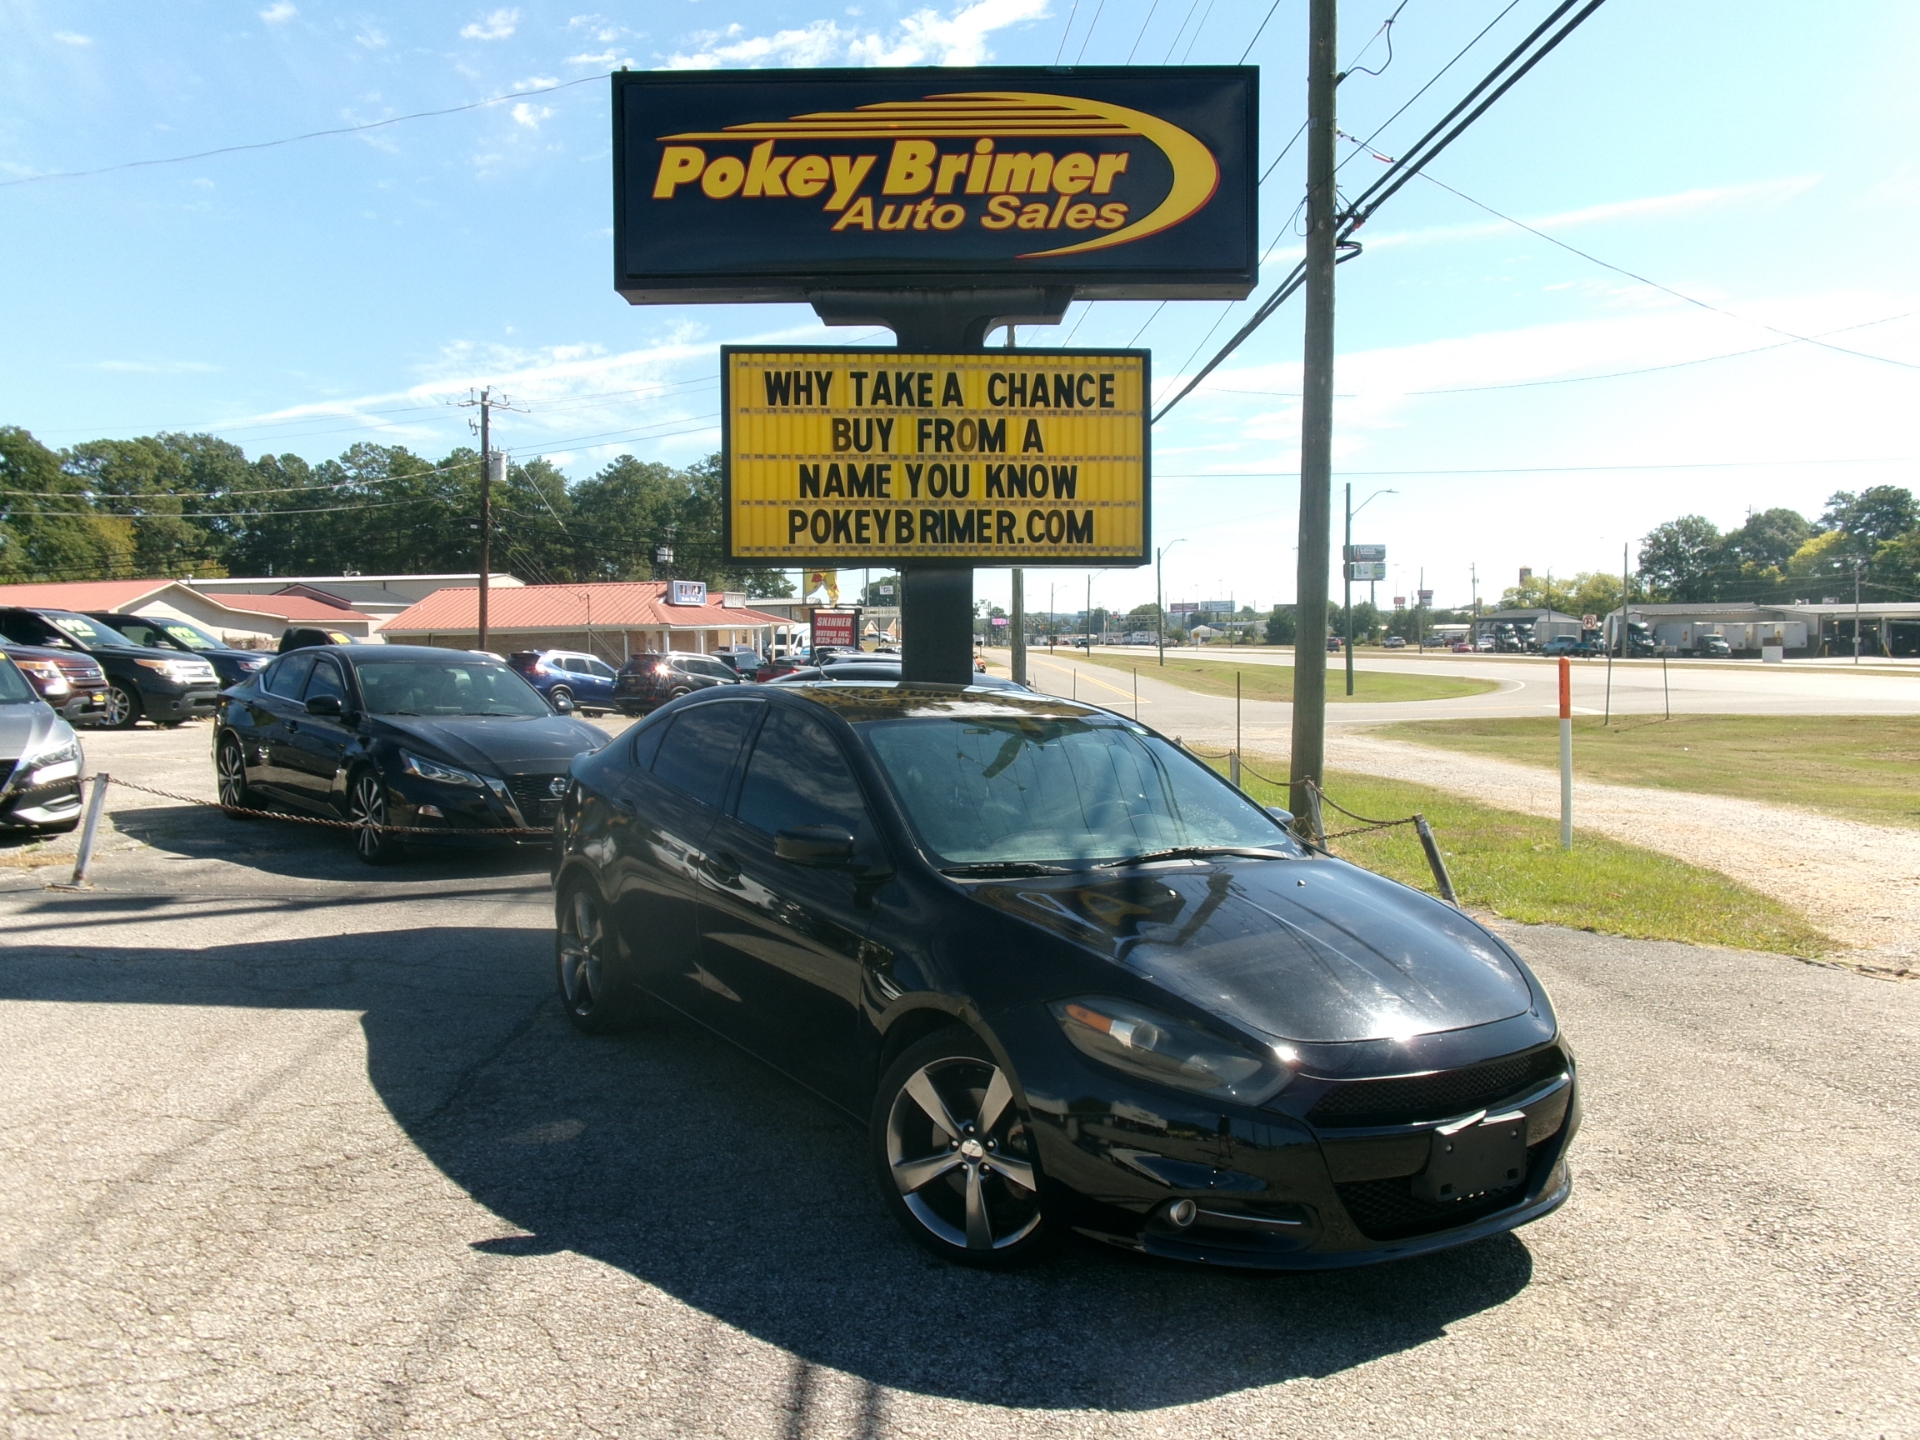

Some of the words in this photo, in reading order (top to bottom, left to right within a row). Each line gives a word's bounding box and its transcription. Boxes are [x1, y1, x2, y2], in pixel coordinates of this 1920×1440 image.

[652, 139, 877, 211] Pokey
[880, 138, 1128, 195] Brimer
[831, 196, 967, 231] Auto
[979, 196, 1129, 230] Sales
[764, 371, 833, 406] WHY
[850, 371, 934, 407] TAKE
[942, 373, 964, 407] A
[987, 373, 1115, 408] CHANCE
[832, 418, 894, 452] BUY
[917, 418, 1006, 453] FROM
[1022, 419, 1044, 453] A
[799, 463, 892, 498] NAME
[905, 463, 970, 498] YOU
[985, 464, 1078, 499] KNOW
[788, 508, 1094, 544] POKEYBRIMER.COM
[816, 616, 851, 626] SKINNER
